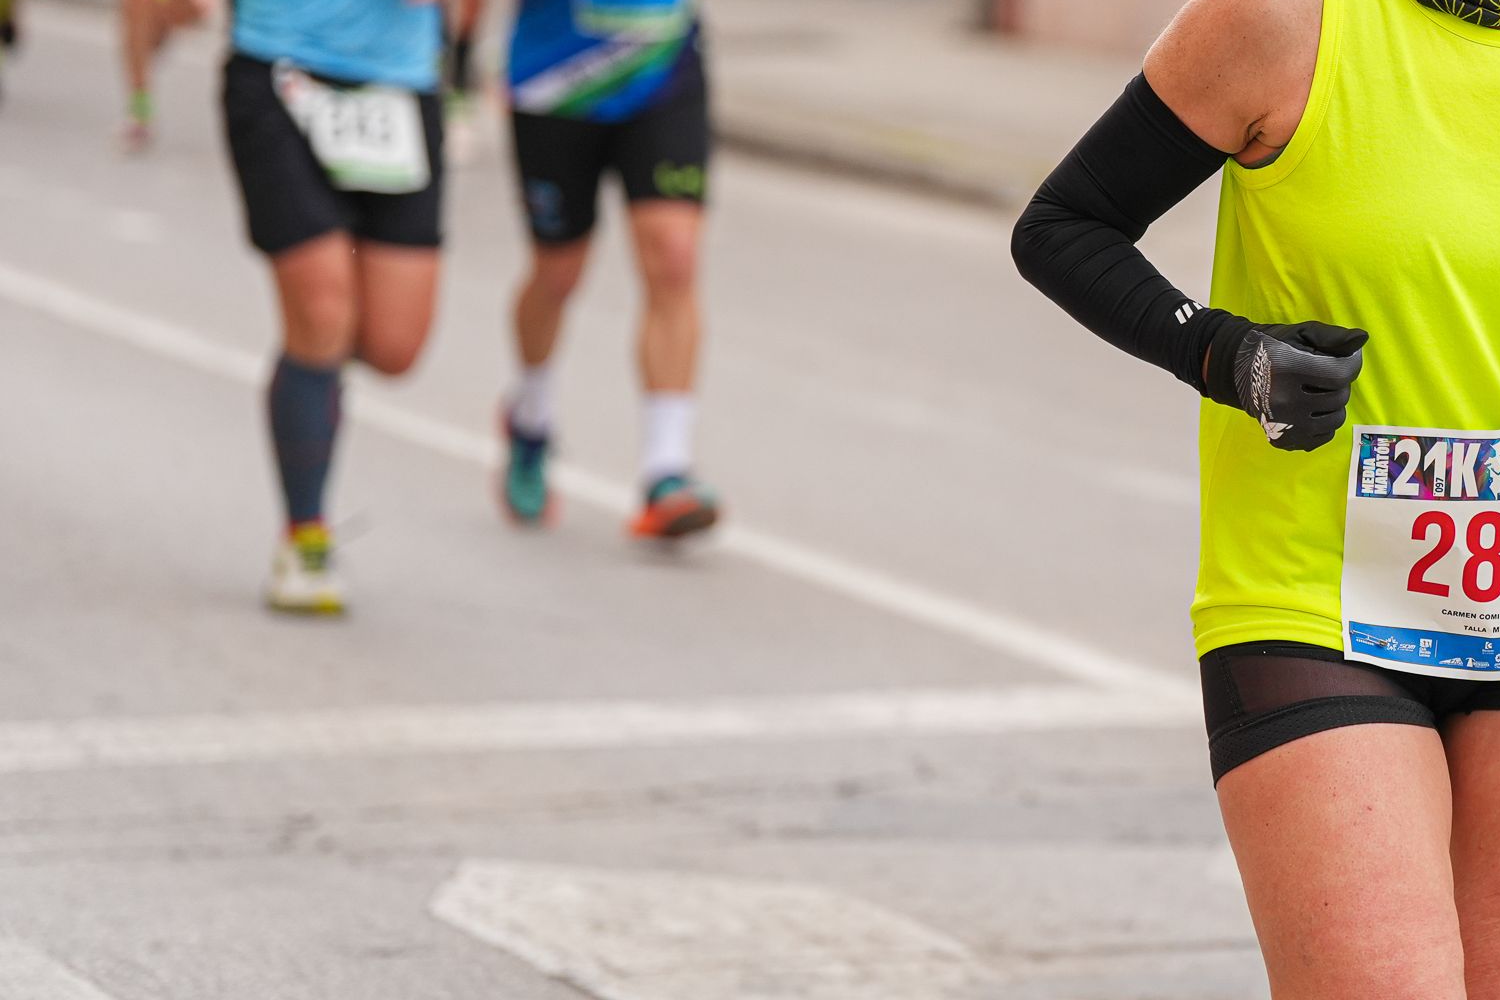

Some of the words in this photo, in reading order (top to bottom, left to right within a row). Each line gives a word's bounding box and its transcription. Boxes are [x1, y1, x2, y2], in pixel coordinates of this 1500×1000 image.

[1361, 458, 1375, 494] MEDIA
[1374, 437, 1390, 495] MARATÓN
[1392, 438, 1481, 498] 21K
[1441, 608, 1477, 619] CARMEN
[1464, 625, 1487, 633] TALLA
